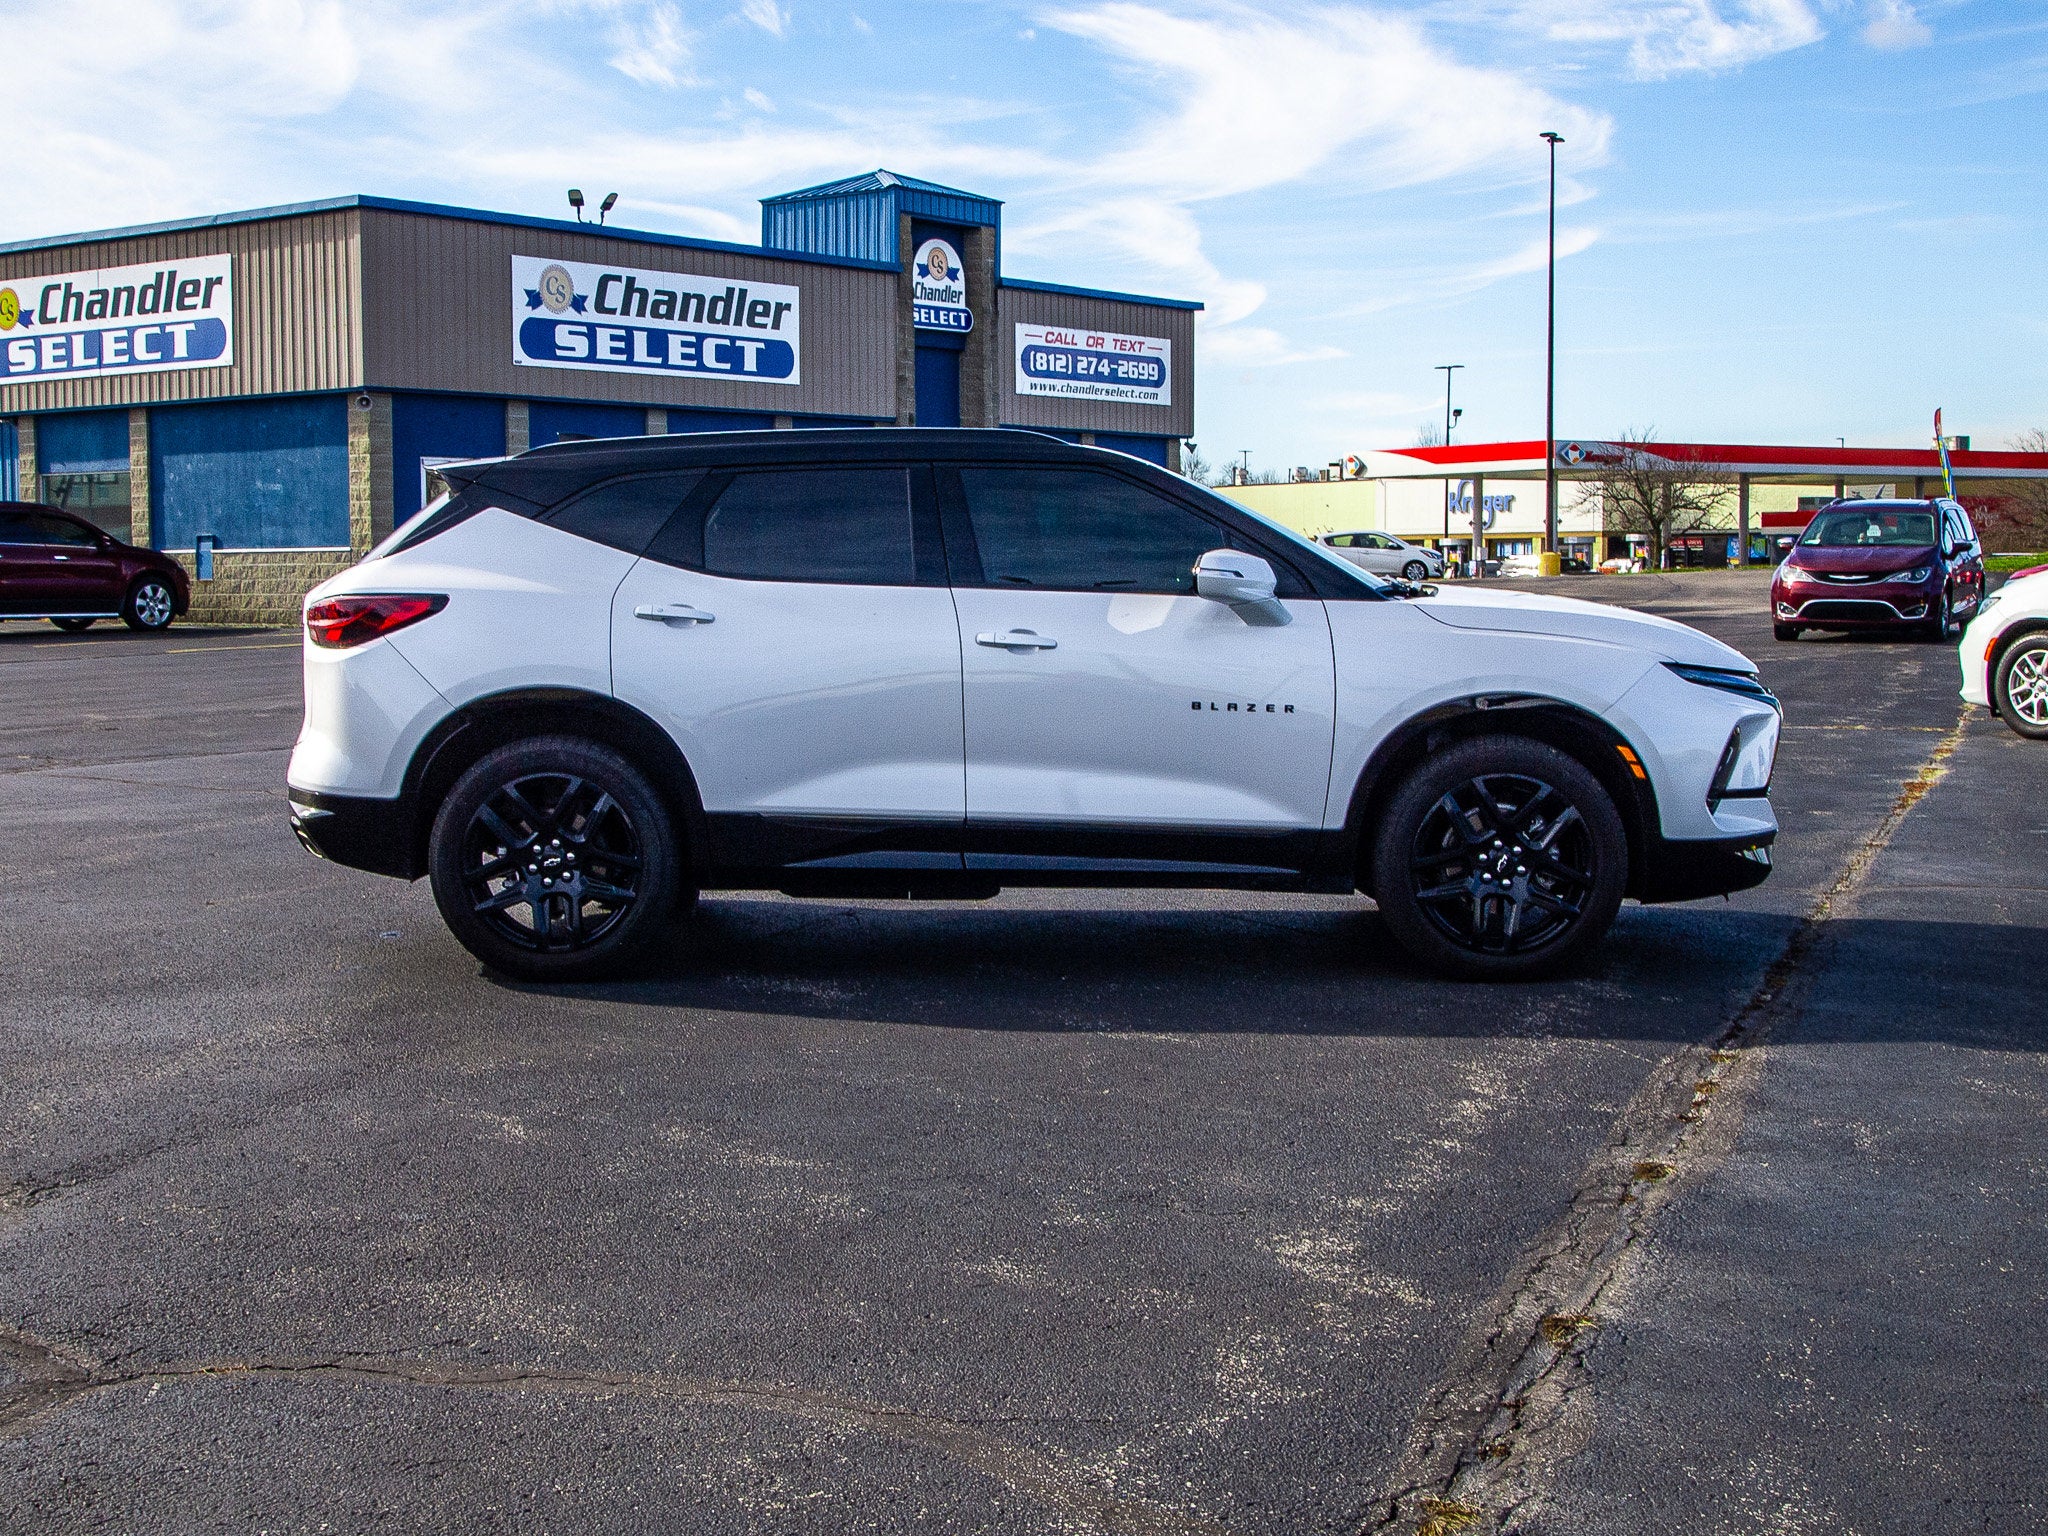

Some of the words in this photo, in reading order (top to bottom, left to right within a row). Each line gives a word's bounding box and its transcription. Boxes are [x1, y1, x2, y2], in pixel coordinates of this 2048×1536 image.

[39, 270, 223, 325] Chandler
[593, 273, 792, 331] Chandler
[914, 281, 963, 304] Chandler
[8, 322, 196, 373] SELECT
[554, 324, 765, 372] SELECT
[1044, 331, 1078, 346] CALL
[1086, 335, 1105, 349] OR
[1112, 338, 1145, 353] TEXT
[1029, 350, 1072, 375] (812)
[1077, 356, 1159, 381] 274-2699
[1029, 381, 1159, 400] www.chandlerselect.com
[1449, 478, 1515, 530] Krger
[1191, 701, 1294, 713] BLAZER
